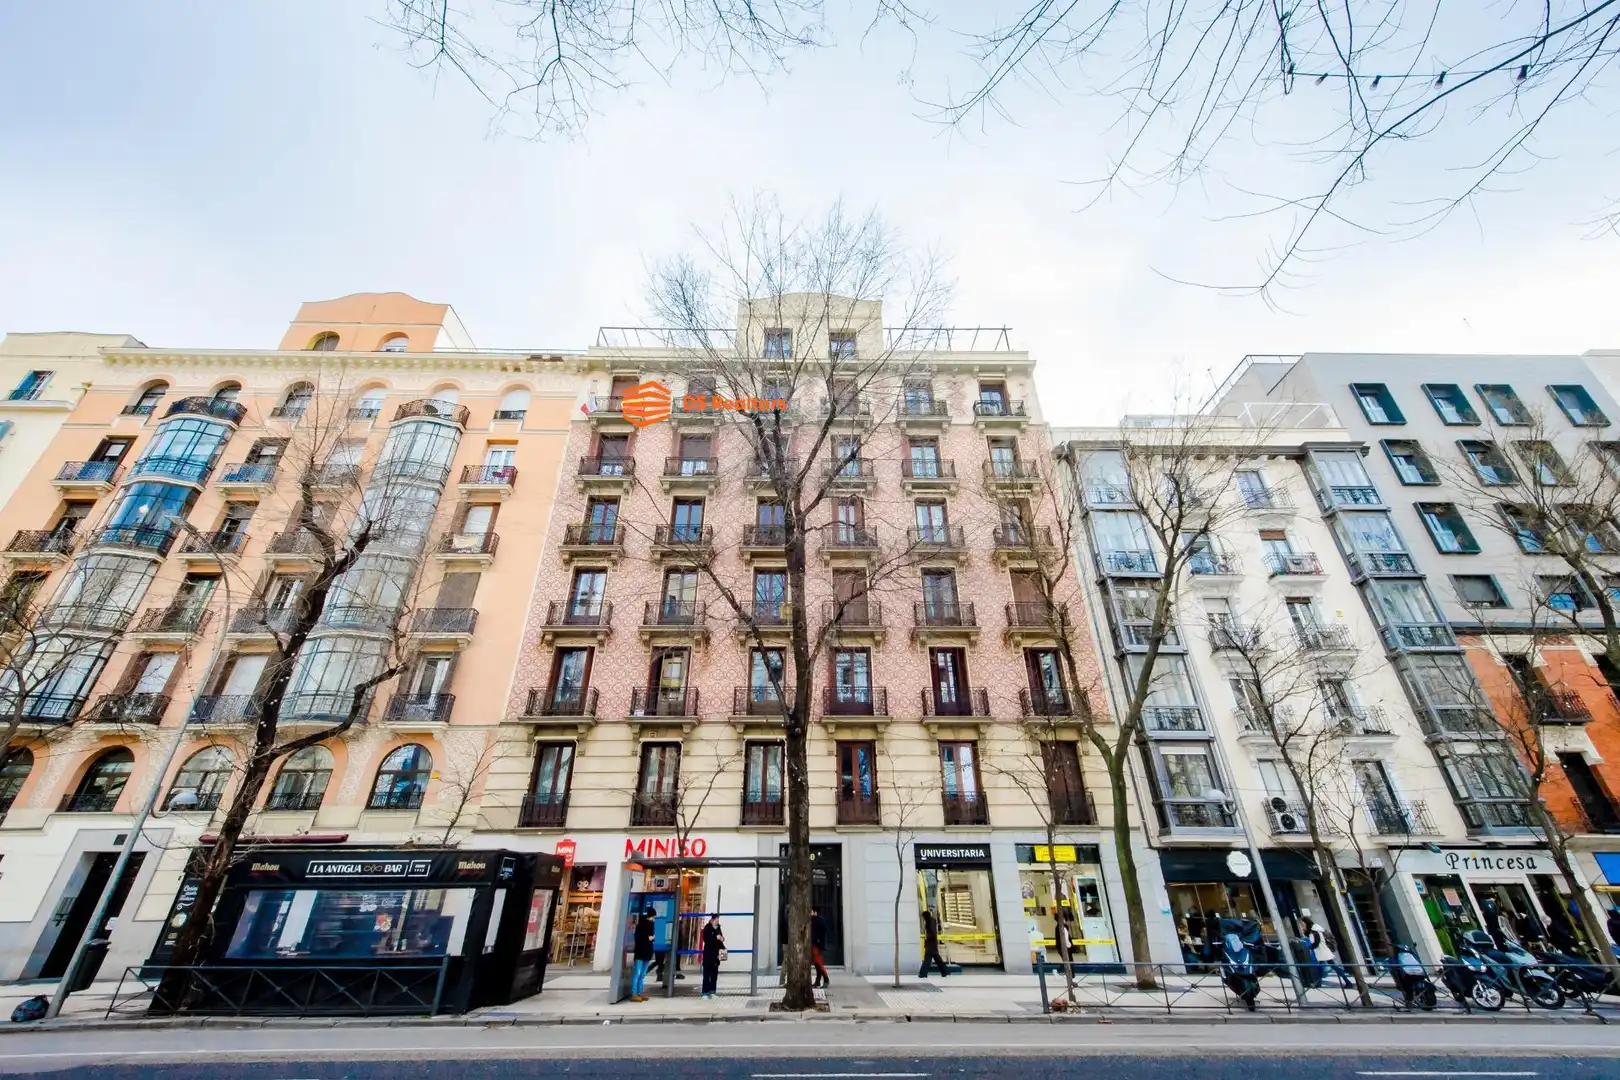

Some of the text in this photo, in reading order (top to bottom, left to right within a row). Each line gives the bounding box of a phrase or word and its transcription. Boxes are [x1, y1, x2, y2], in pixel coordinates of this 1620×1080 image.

[920, 849, 985, 860] UNIVERSITARIA
[458, 861, 486, 870] Mahou
[1445, 852, 1538, 870] Princesa
[312, 864, 402, 873] LA ANTIGUA BAR
